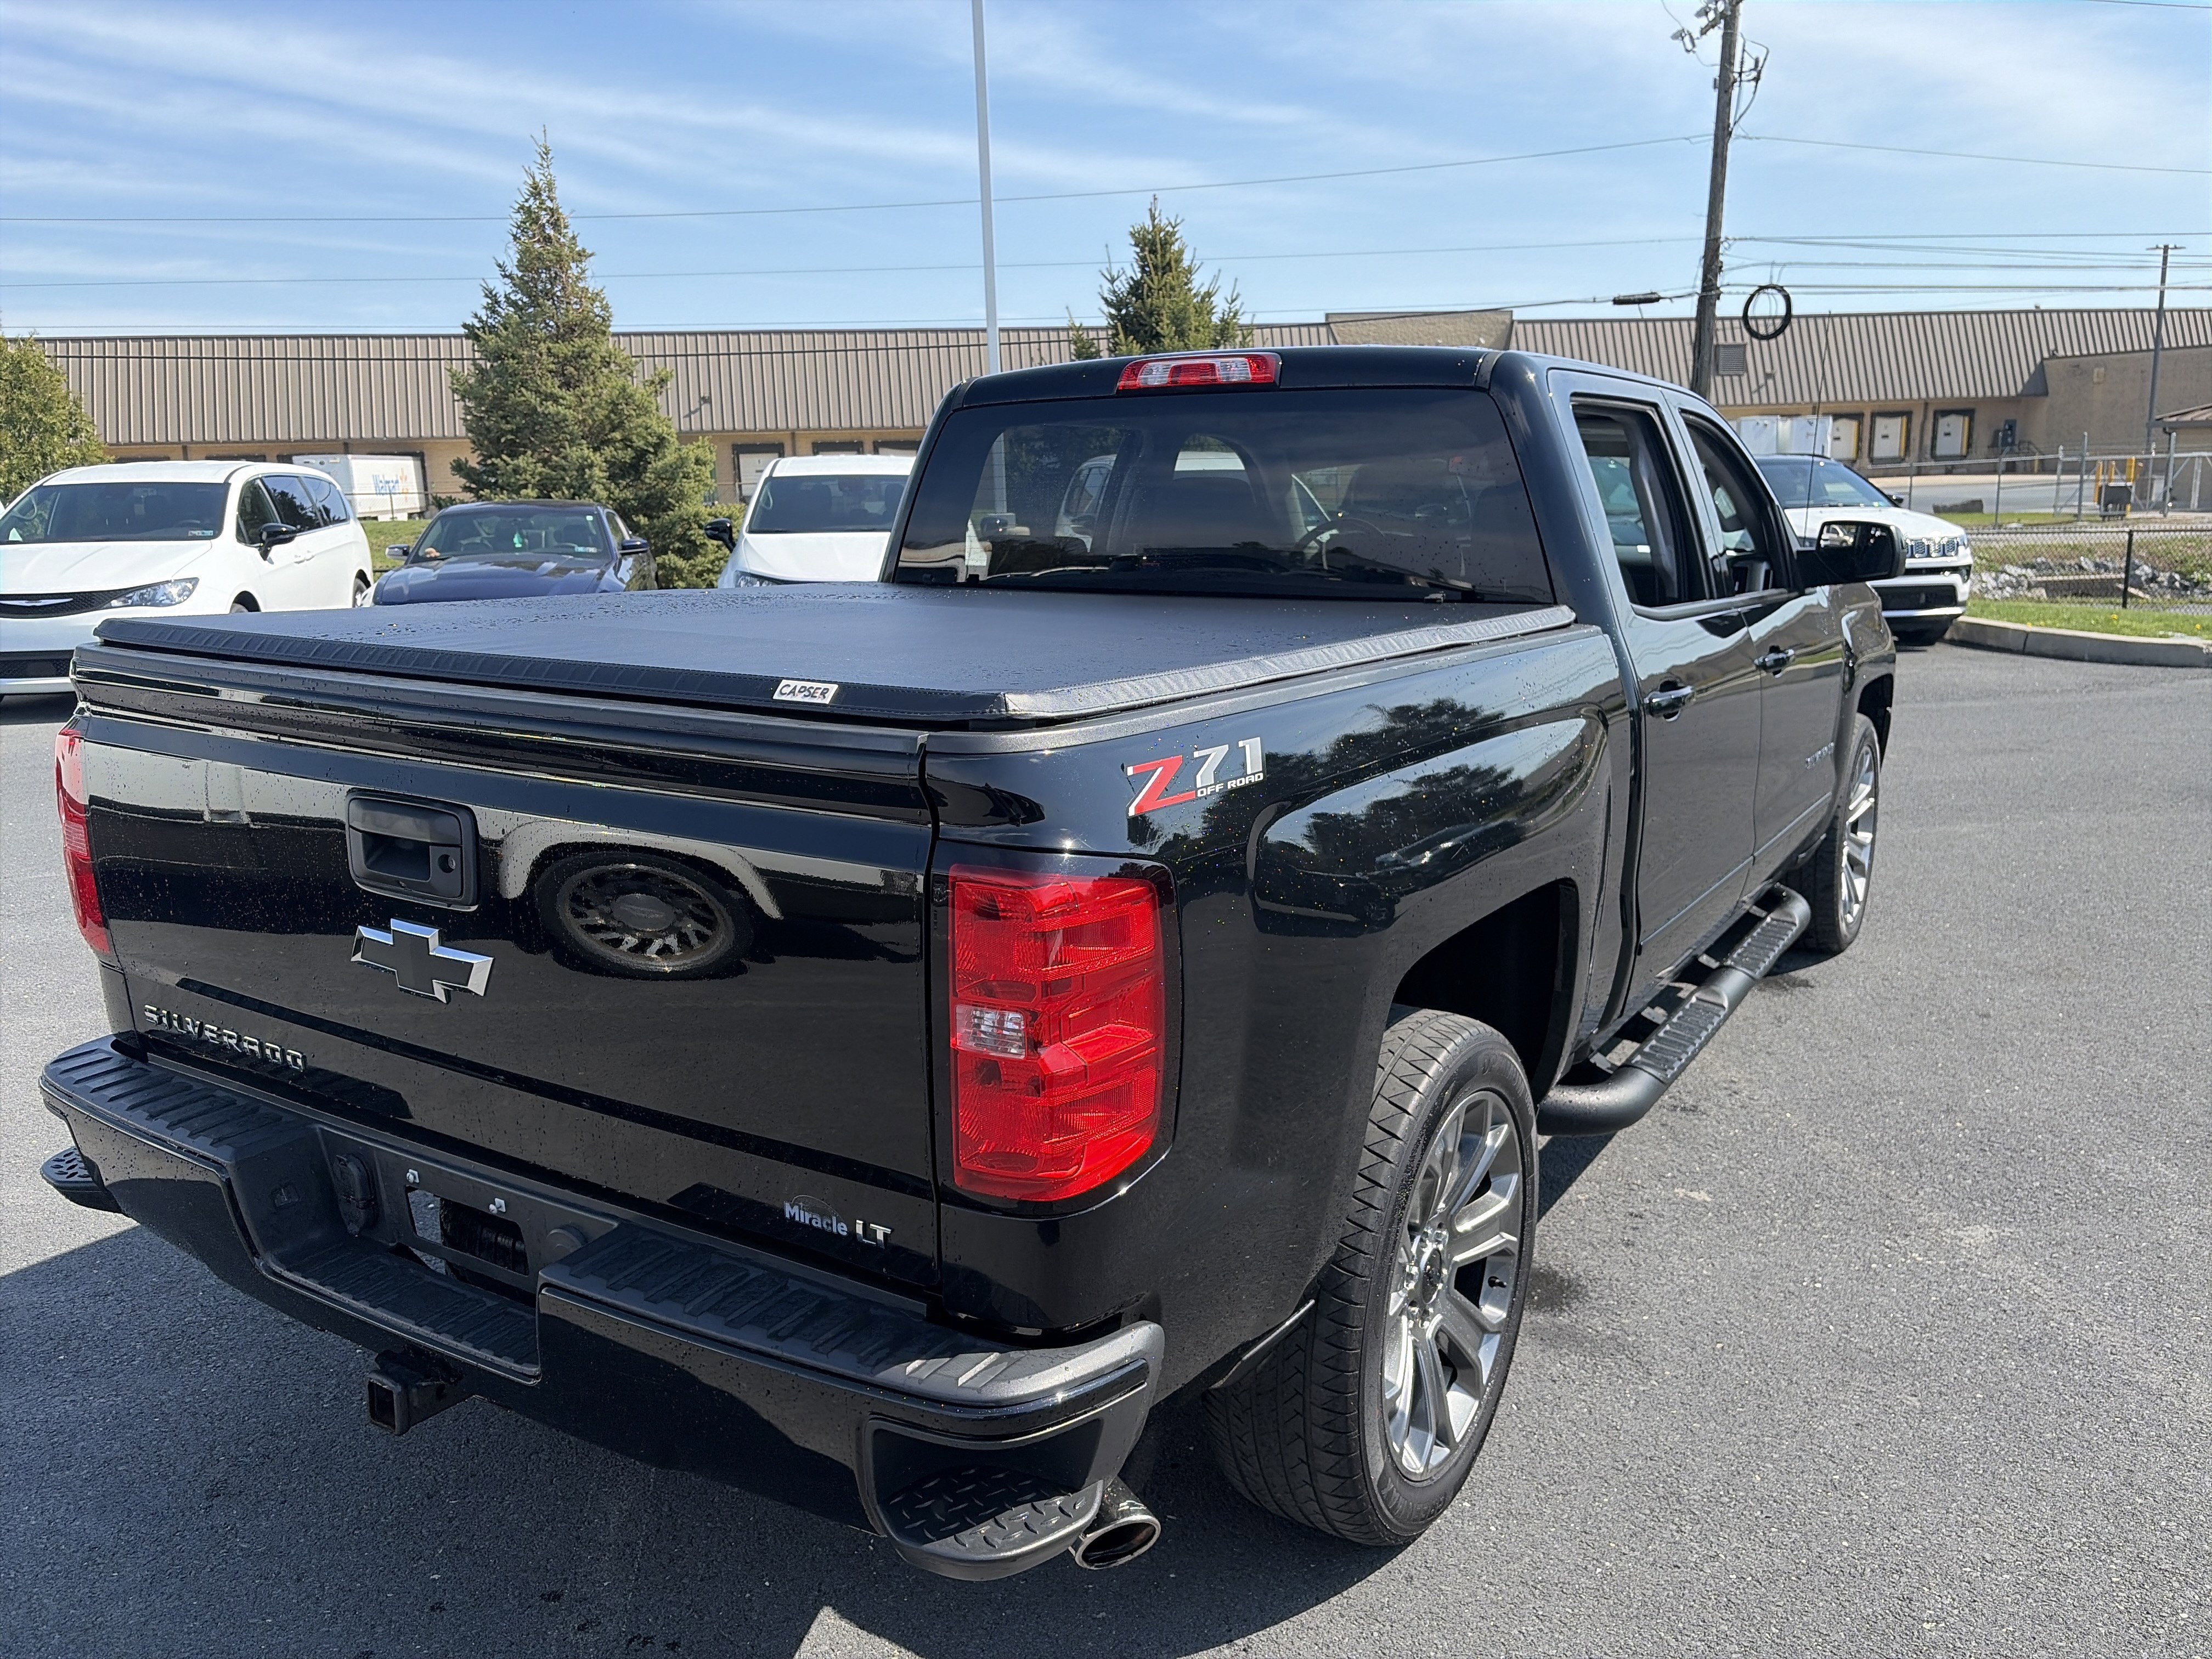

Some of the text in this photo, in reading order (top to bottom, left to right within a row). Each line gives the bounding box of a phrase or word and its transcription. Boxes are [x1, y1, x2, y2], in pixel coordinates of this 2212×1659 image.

[780, 684, 830, 699] CAPSER
[1127, 736, 1263, 816] Z71
[1197, 772, 1263, 797] OFF ROAD
[144, 1004, 307, 1072] SILVERADO
[783, 1200, 848, 1237] Miracle
[856, 1219, 892, 1249] LT
